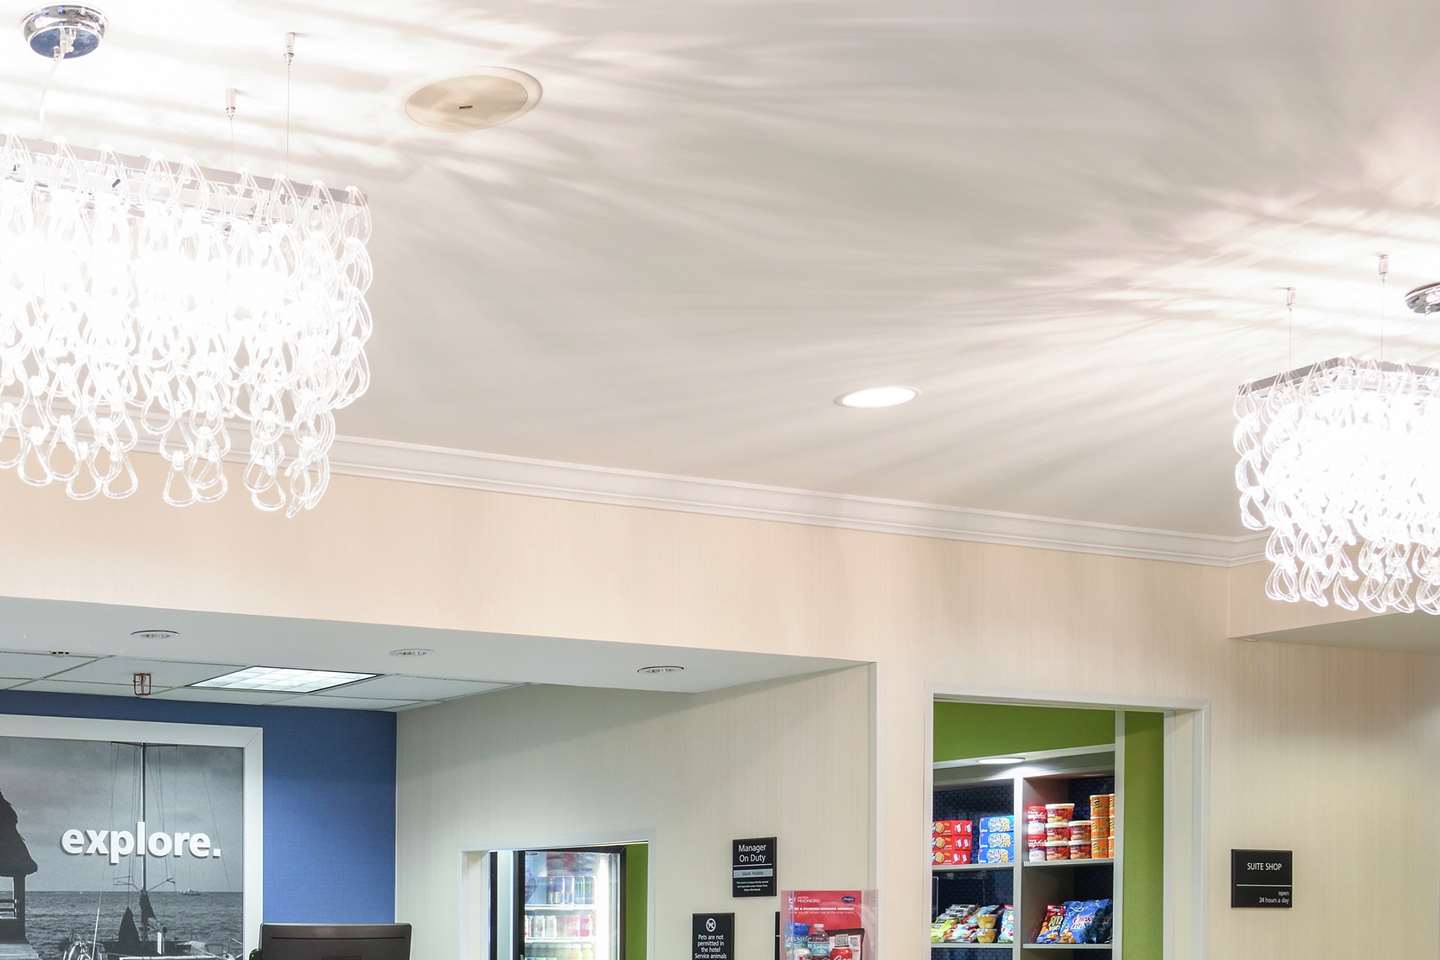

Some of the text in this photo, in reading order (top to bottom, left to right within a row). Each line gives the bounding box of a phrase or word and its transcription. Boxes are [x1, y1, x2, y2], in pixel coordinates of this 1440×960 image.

[61, 821, 222, 865] explore.
[738, 844, 766, 853] Manager
[739, 854, 766, 863] On Duty
[1247, 862, 1282, 871] SUITE SHOP
